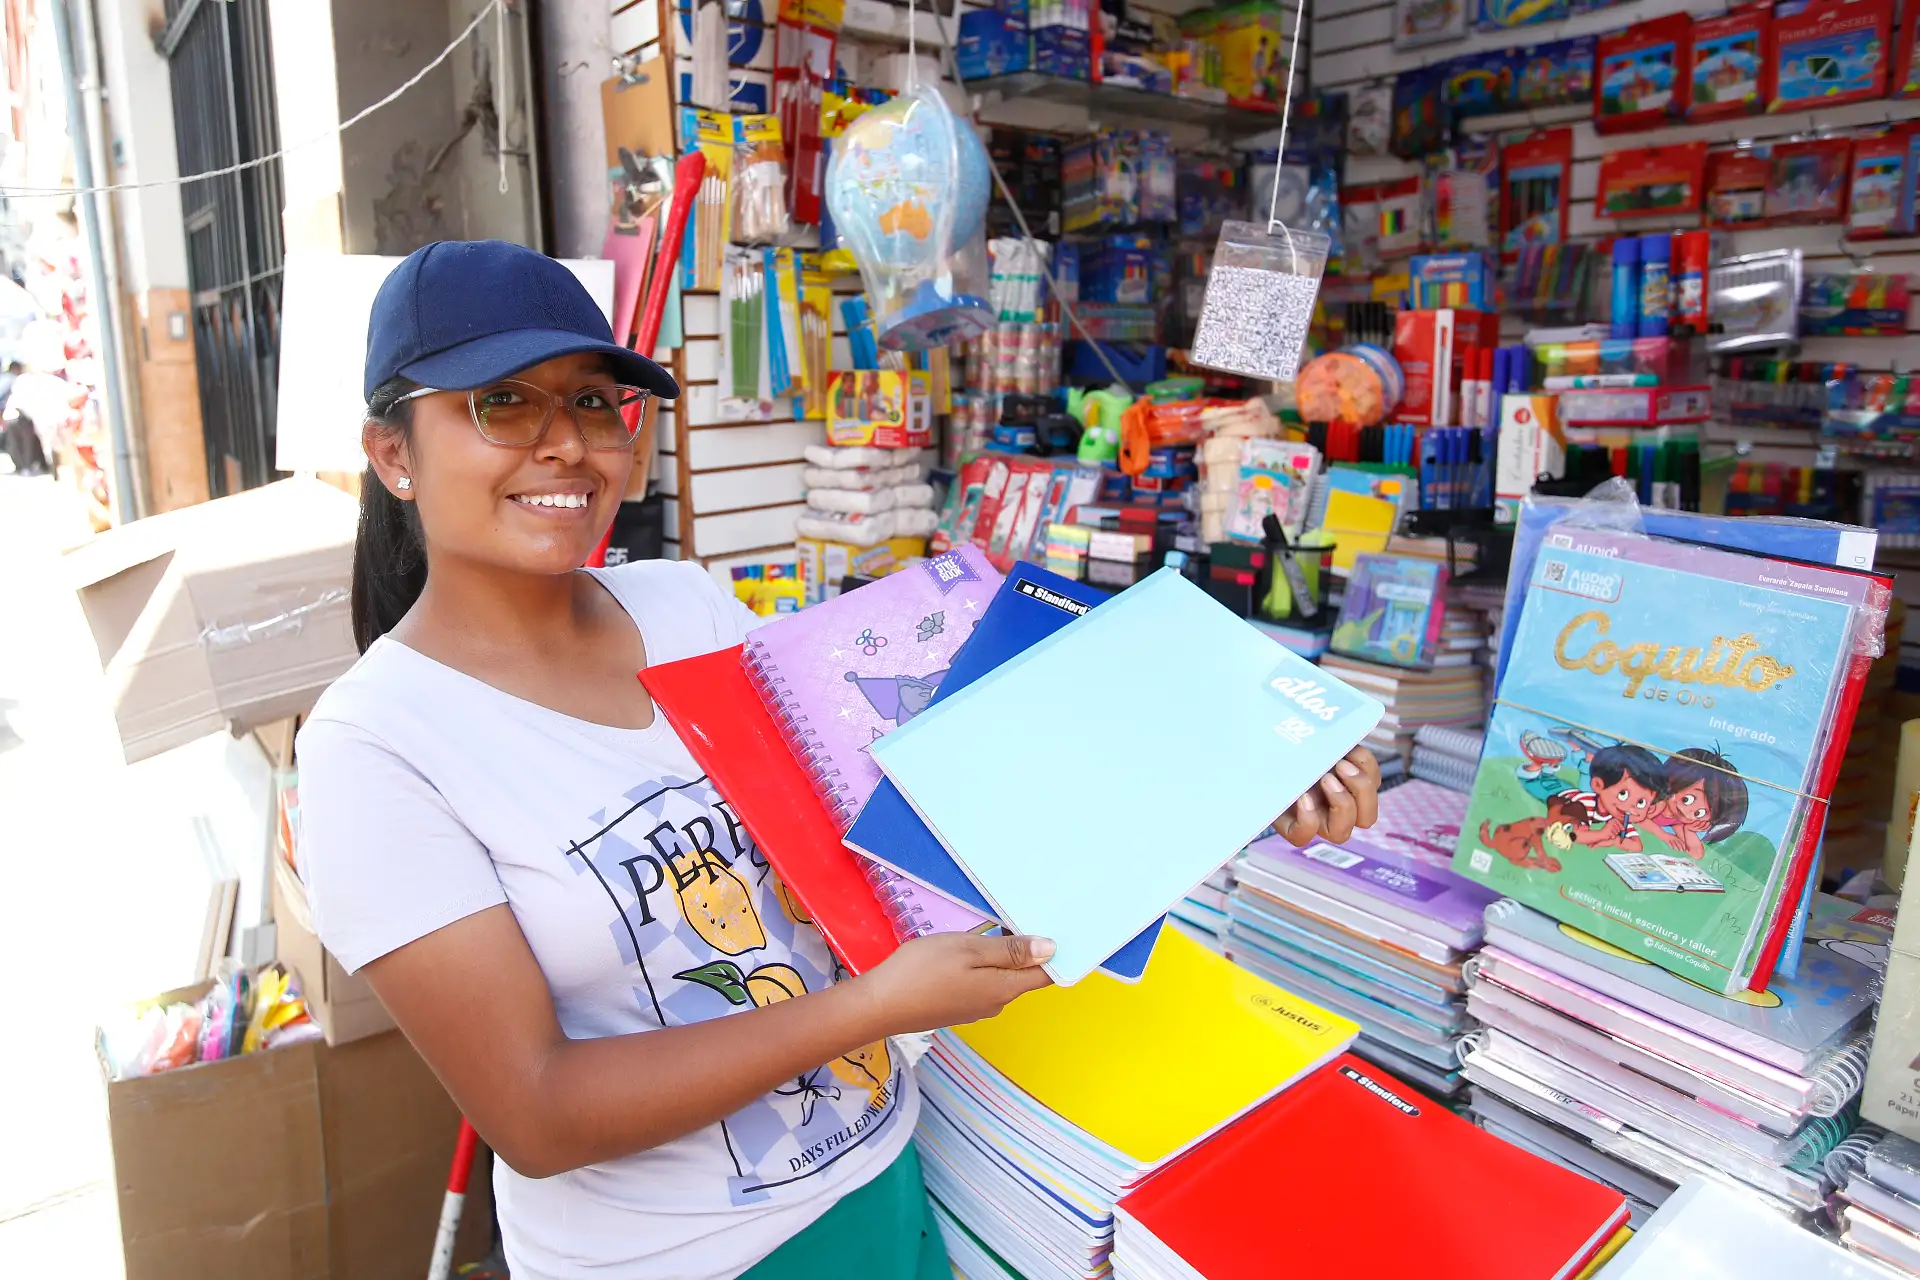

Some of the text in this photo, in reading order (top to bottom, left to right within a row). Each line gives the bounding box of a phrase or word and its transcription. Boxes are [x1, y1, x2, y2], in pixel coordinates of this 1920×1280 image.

[935, 559, 958, 574] STYLE
[938, 568, 965, 583] BOOK
[1571, 569, 1615, 588] AUDIO
[1568, 579, 1613, 600] LIBRO
[1758, 574, 1787, 586] Everardo
[1034, 587, 1087, 616] Standford
[1554, 610, 1796, 698] Coquito
[1270, 677, 1340, 720] atlas
[1643, 686, 1715, 709] de Oro
[1708, 716, 1776, 744] Integrado
[1568, 886, 1717, 958] Lectura inicial, escritura y taller.
[1653, 941, 1684, 961] Ediciones
[1271, 1004, 1321, 1031] Justus
[1358, 1076, 1414, 1113] Standford
[1887, 1099, 1919, 1119] Papel
[788, 1089, 893, 1172] DAYS FILLED WITH
